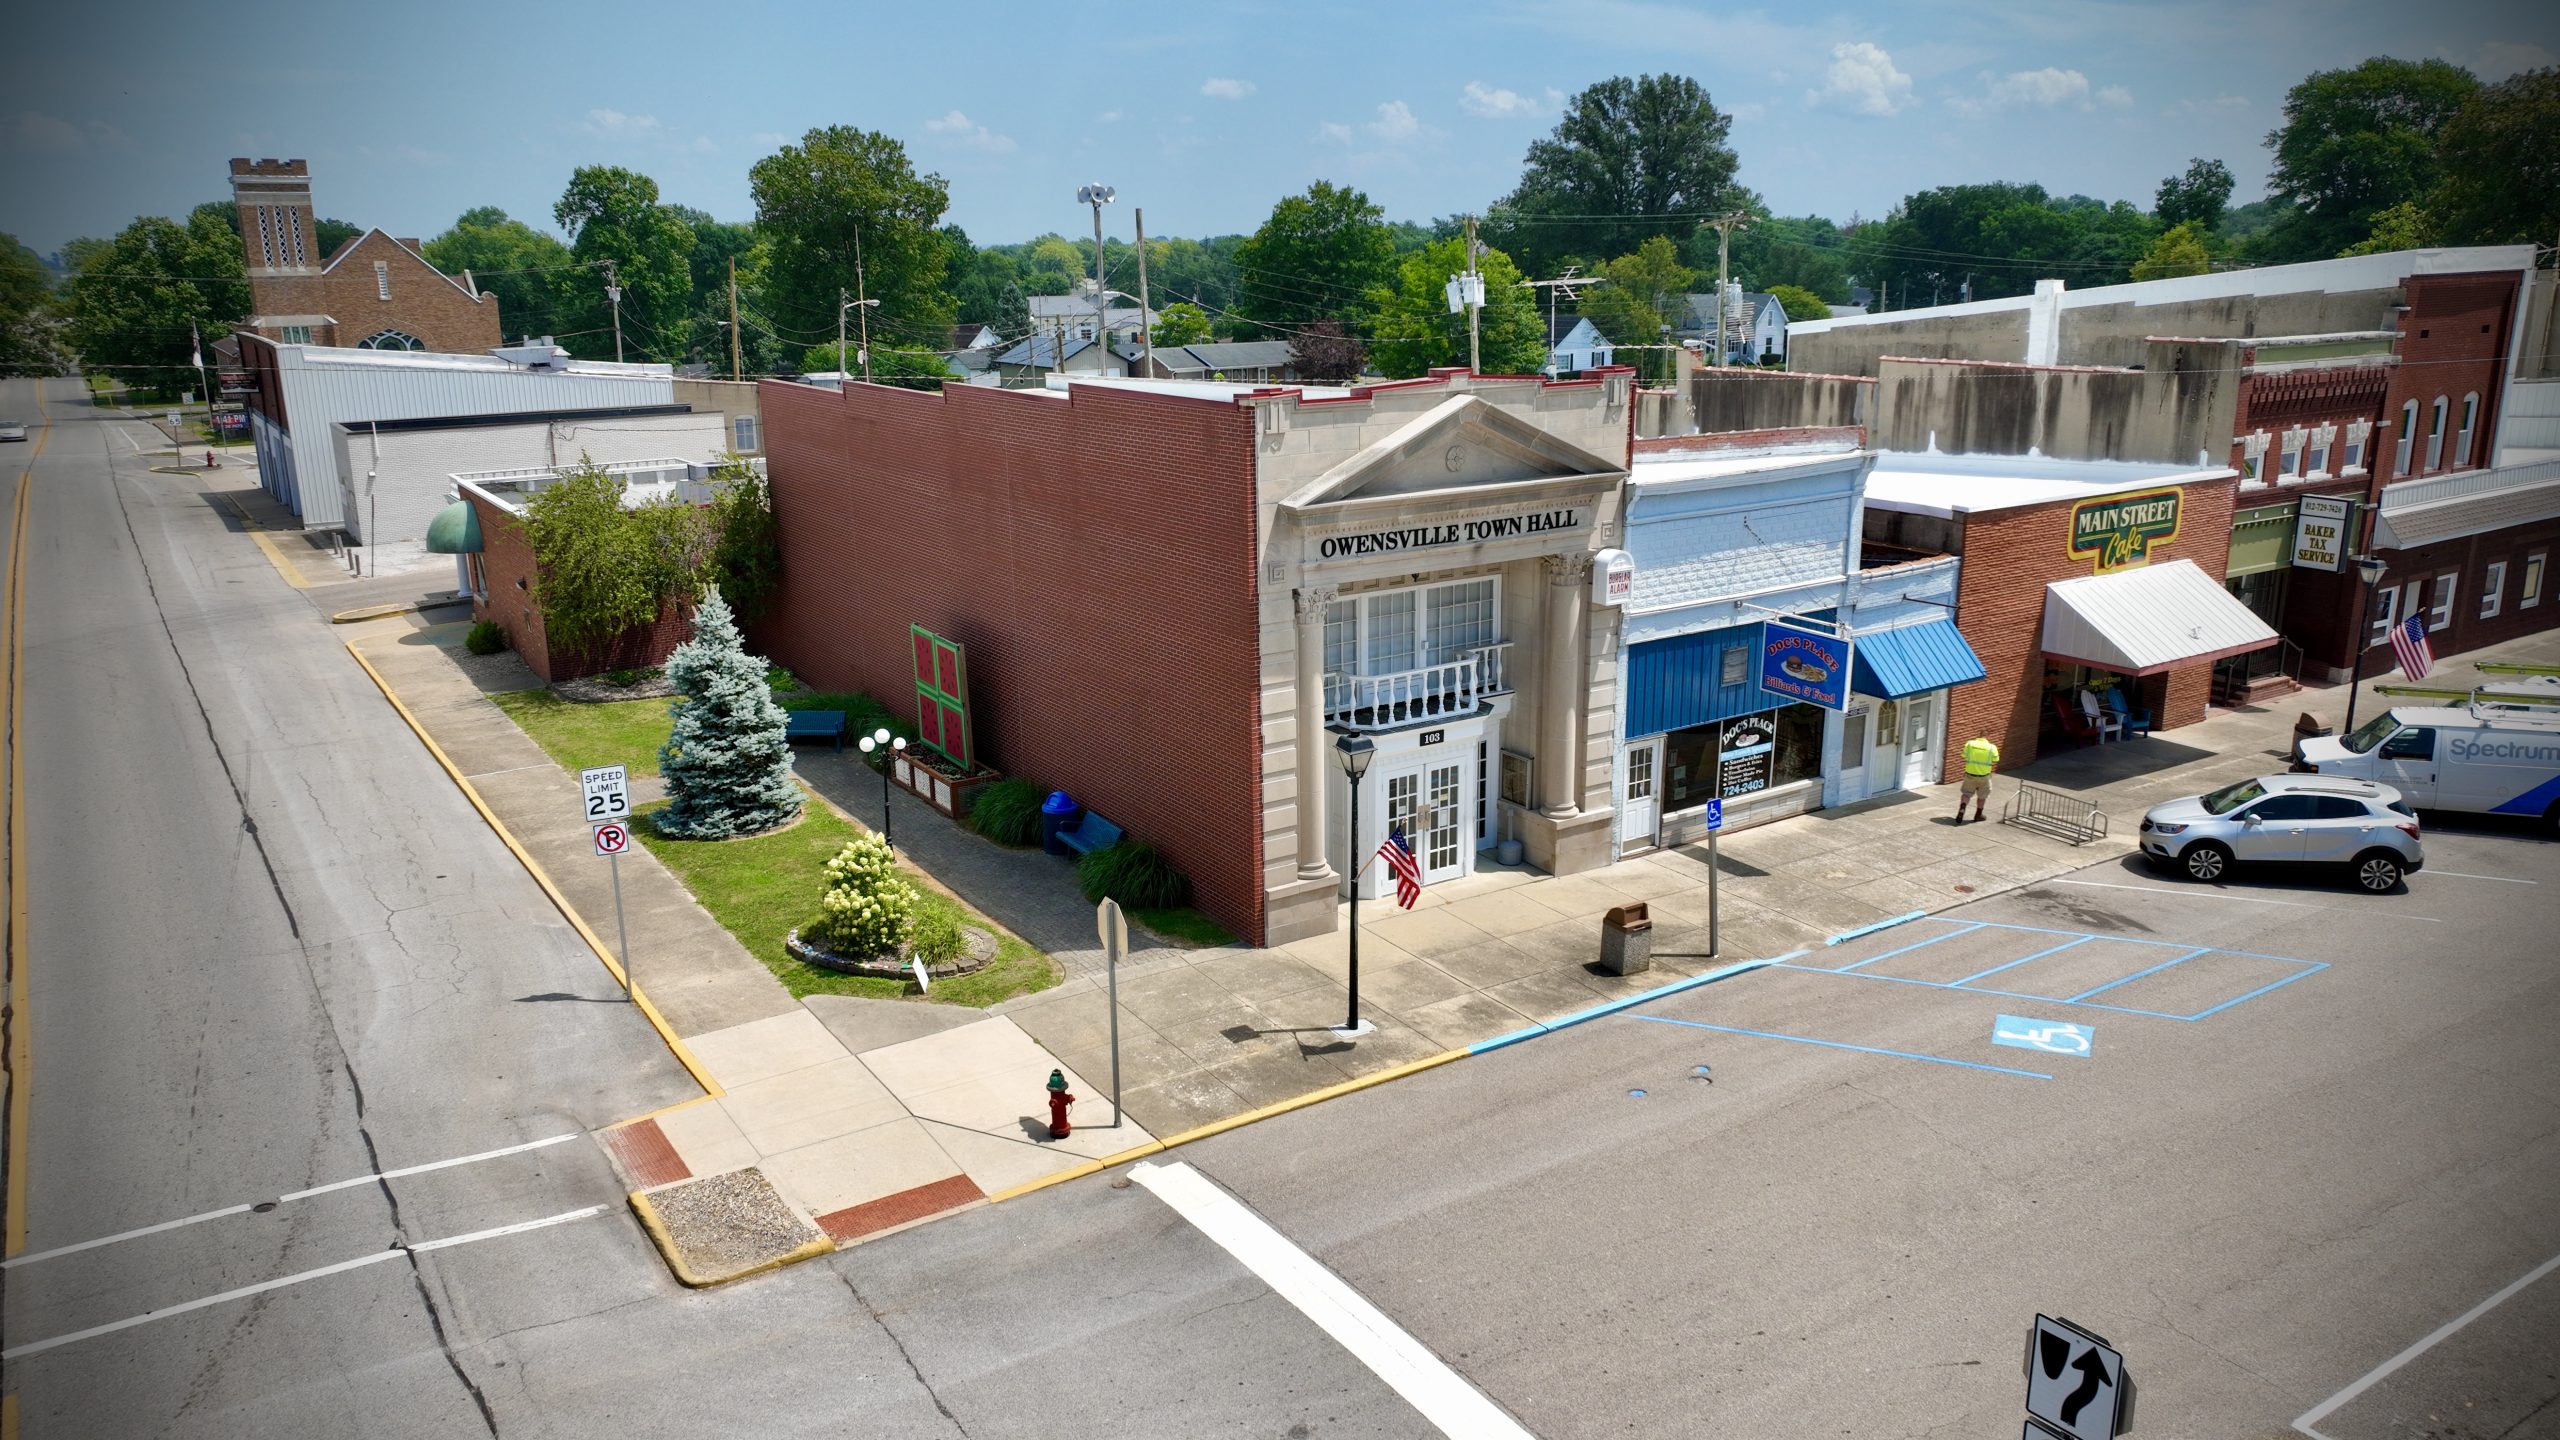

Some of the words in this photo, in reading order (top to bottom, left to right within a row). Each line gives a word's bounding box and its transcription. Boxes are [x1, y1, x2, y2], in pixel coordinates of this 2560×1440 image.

[2078, 508, 2119, 534] MAIN
[2120, 499, 2176, 527] STREET
[1320, 524, 1460, 558] OWENSVILLE
[1464, 516, 1523, 540] TOWN
[1526, 510, 1578, 533] HALL
[2304, 524, 2336, 538] BAKER
[2104, 526, 2142, 569] Cafe
[2309, 538, 2328, 550] TAX
[2297, 549, 2335, 564] SERVICE
[1609, 583, 1629, 594] ALARM
[1767, 636, 1801, 656] DOC'S
[1802, 638, 1840, 673] PLACE
[1765, 675, 1801, 694] Billiards
[1812, 688, 1836, 704] Food
[1424, 732, 1441, 744] 103
[1722, 719, 1748, 746] DOC'S
[1749, 717, 1774, 735] PLACE
[2450, 738, 2560, 760] Spectrum
[1729, 754, 1764, 766] Sandwiches
[585, 771, 623, 784] SPEED
[590, 782, 620, 794] LIMIT
[1723, 778, 1765, 797] 724-2403
[588, 792, 626, 816] 25
